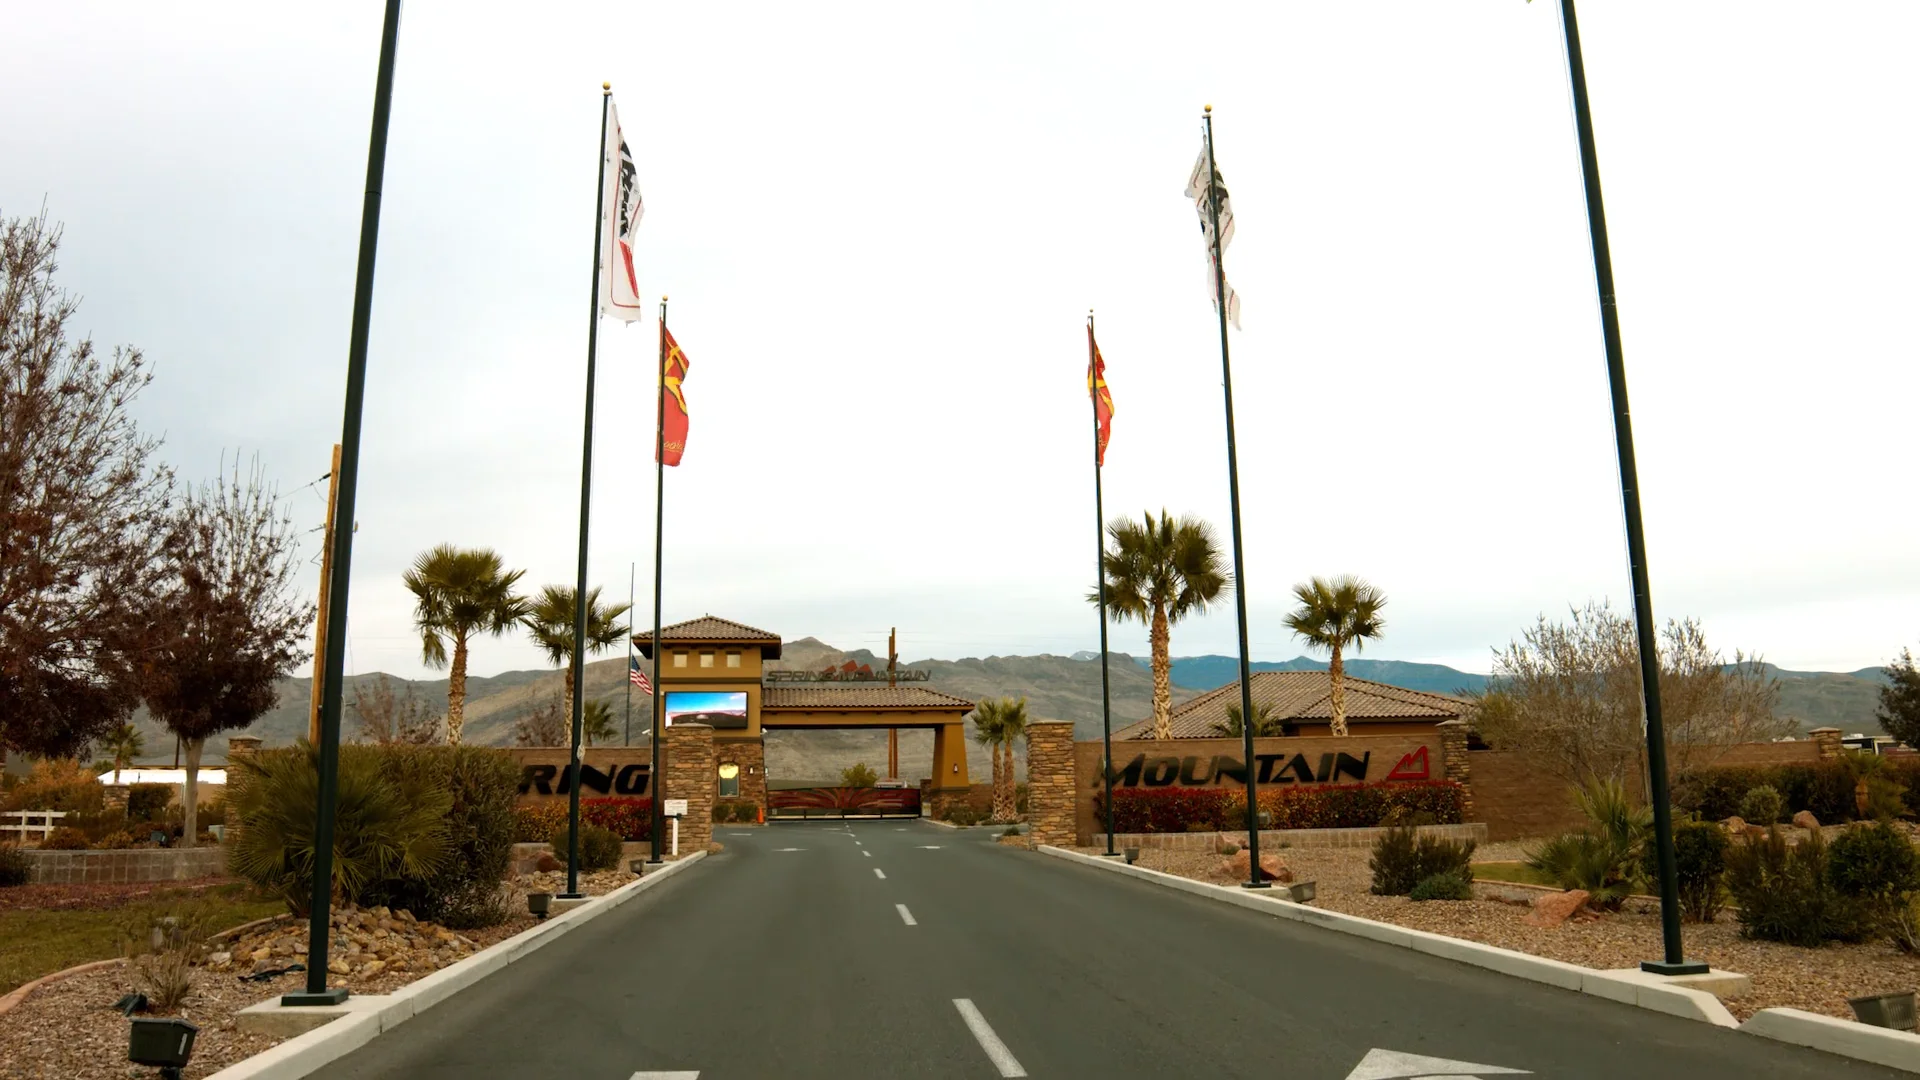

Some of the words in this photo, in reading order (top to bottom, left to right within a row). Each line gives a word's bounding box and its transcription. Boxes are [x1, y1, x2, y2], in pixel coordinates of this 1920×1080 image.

[766, 670, 834, 682] SPRING
[837, 669, 932, 682] MOUNTAIN
[1092, 751, 1371, 787] MOUNTAIN
